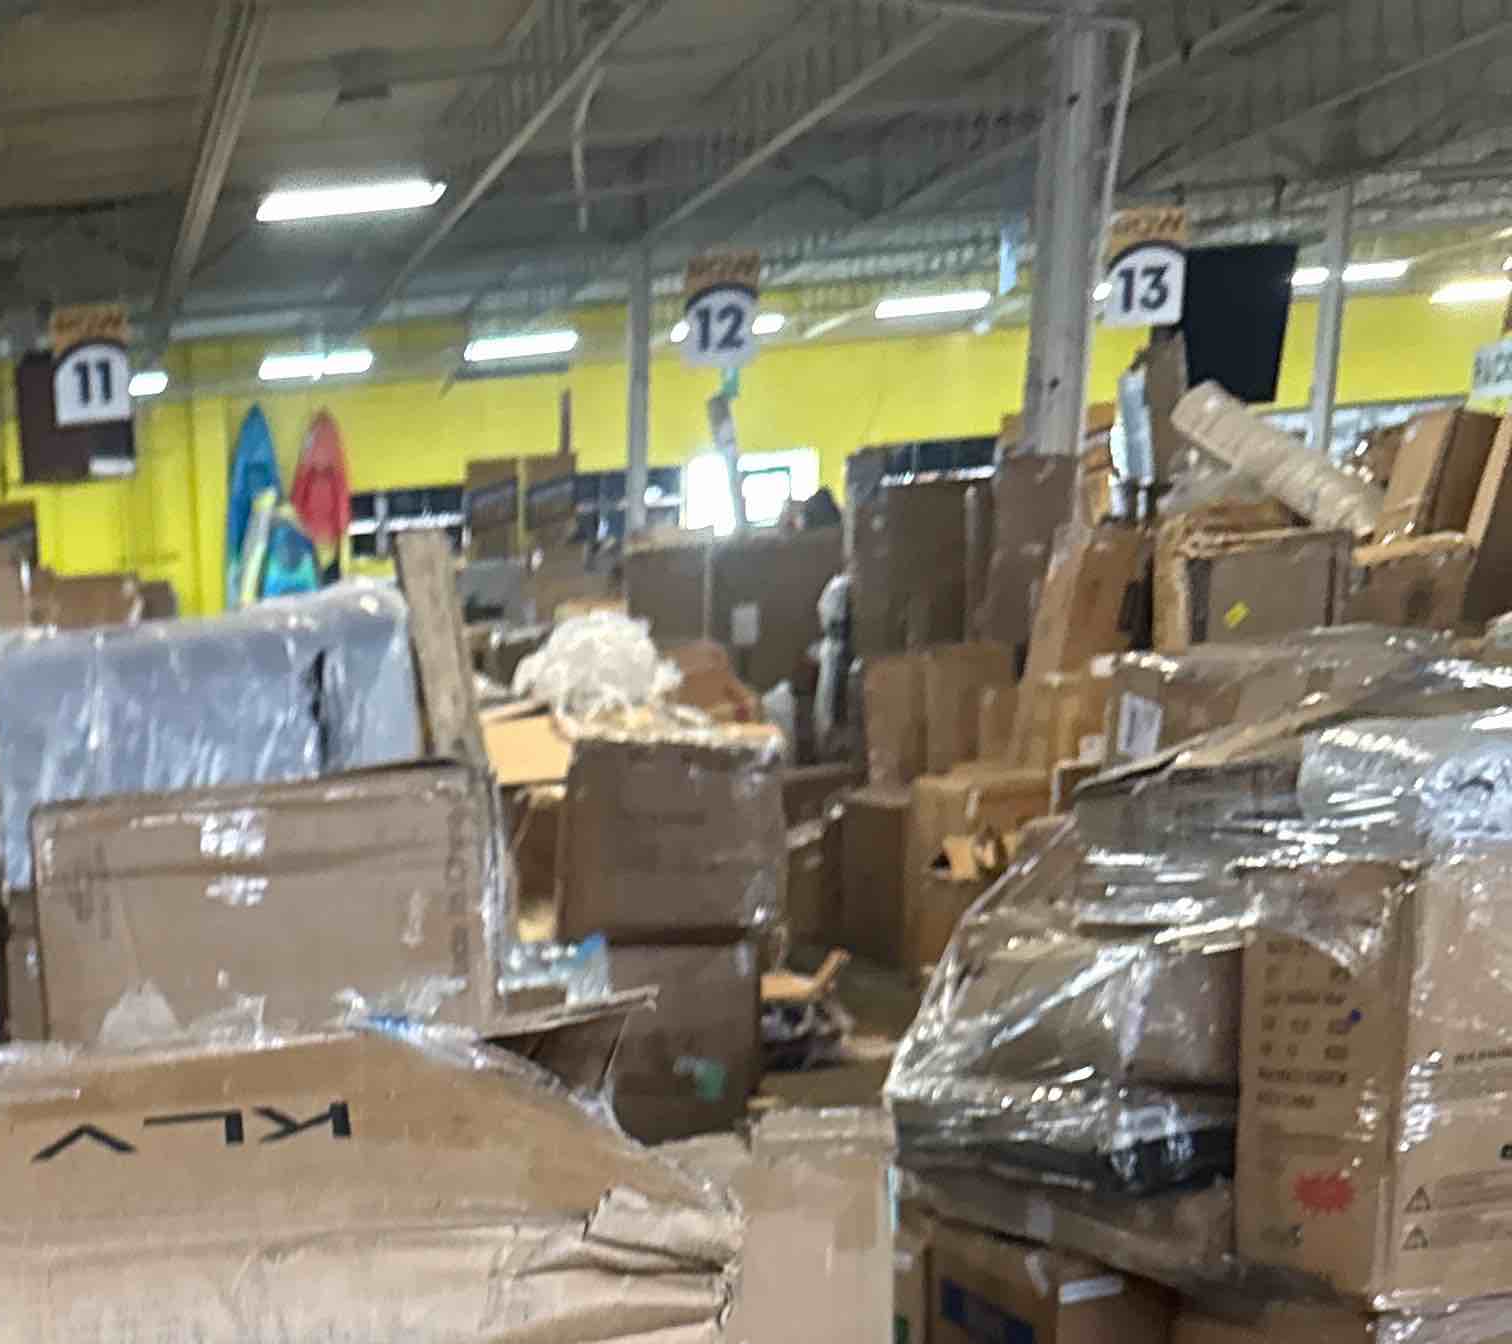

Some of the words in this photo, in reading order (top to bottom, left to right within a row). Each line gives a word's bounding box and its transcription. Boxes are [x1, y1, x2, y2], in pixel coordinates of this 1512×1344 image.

[1117, 262, 1170, 312] 13
[695, 304, 745, 352] 12
[73, 359, 113, 405] 11
[32, 1102, 352, 1163] KLV
